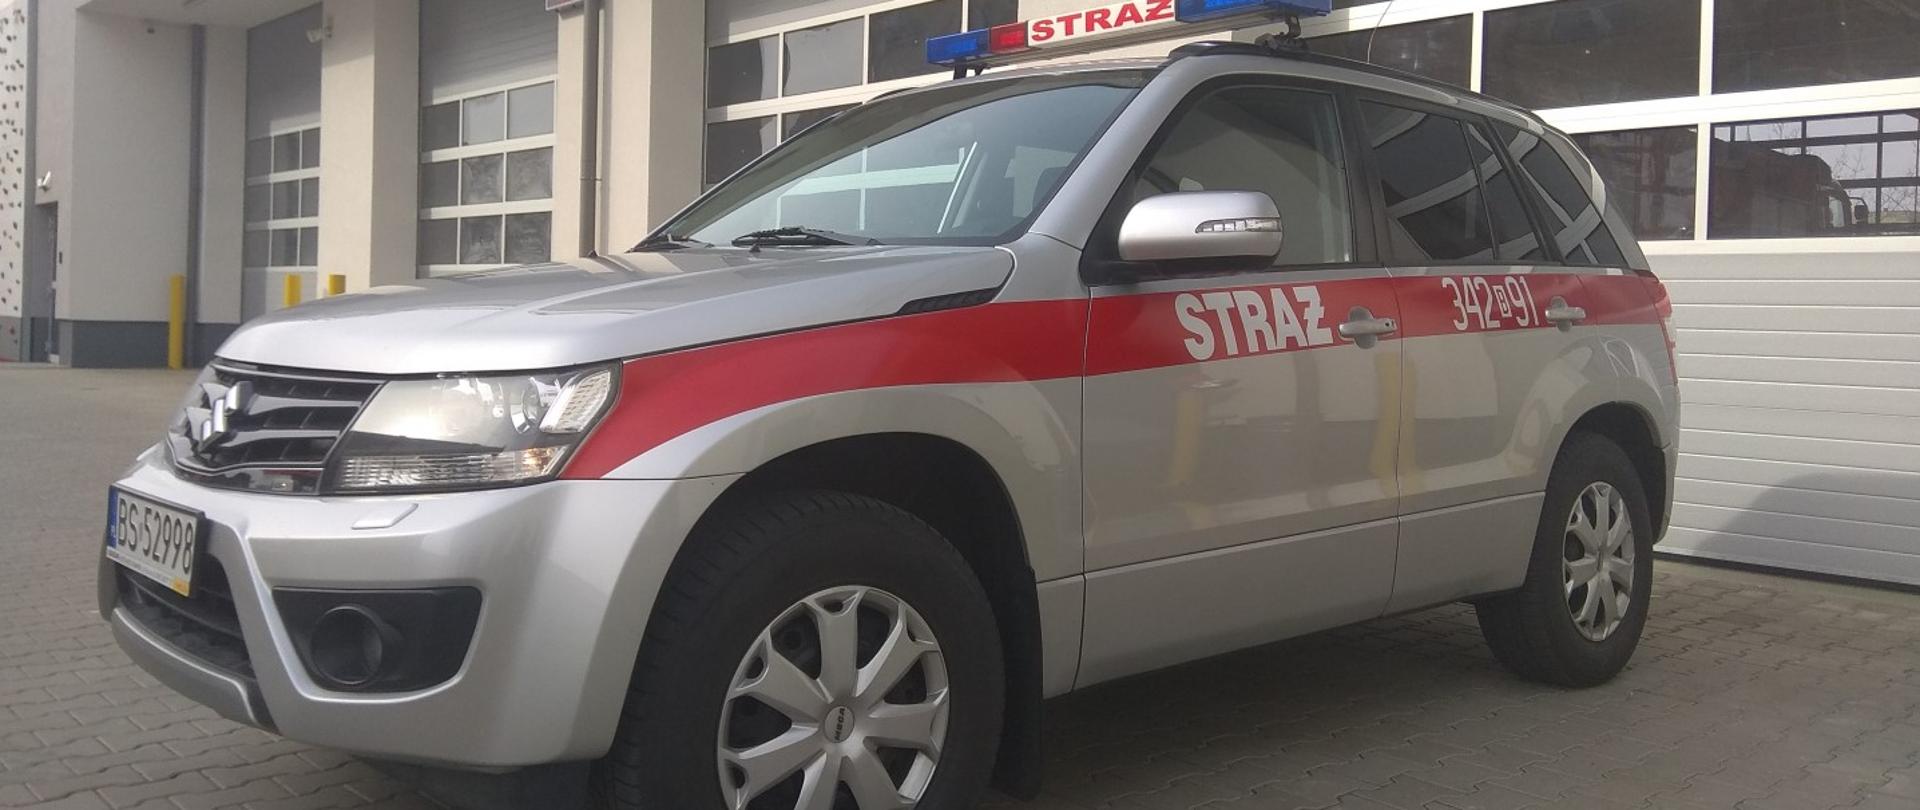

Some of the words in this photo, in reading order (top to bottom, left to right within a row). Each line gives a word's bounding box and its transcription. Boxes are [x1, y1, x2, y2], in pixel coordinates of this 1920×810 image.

[1174, 285, 1333, 360] STRAŻ
[118, 498, 138, 552] BS
[143, 506, 194, 575] 52998
[834, 707, 846, 741] MEGA
